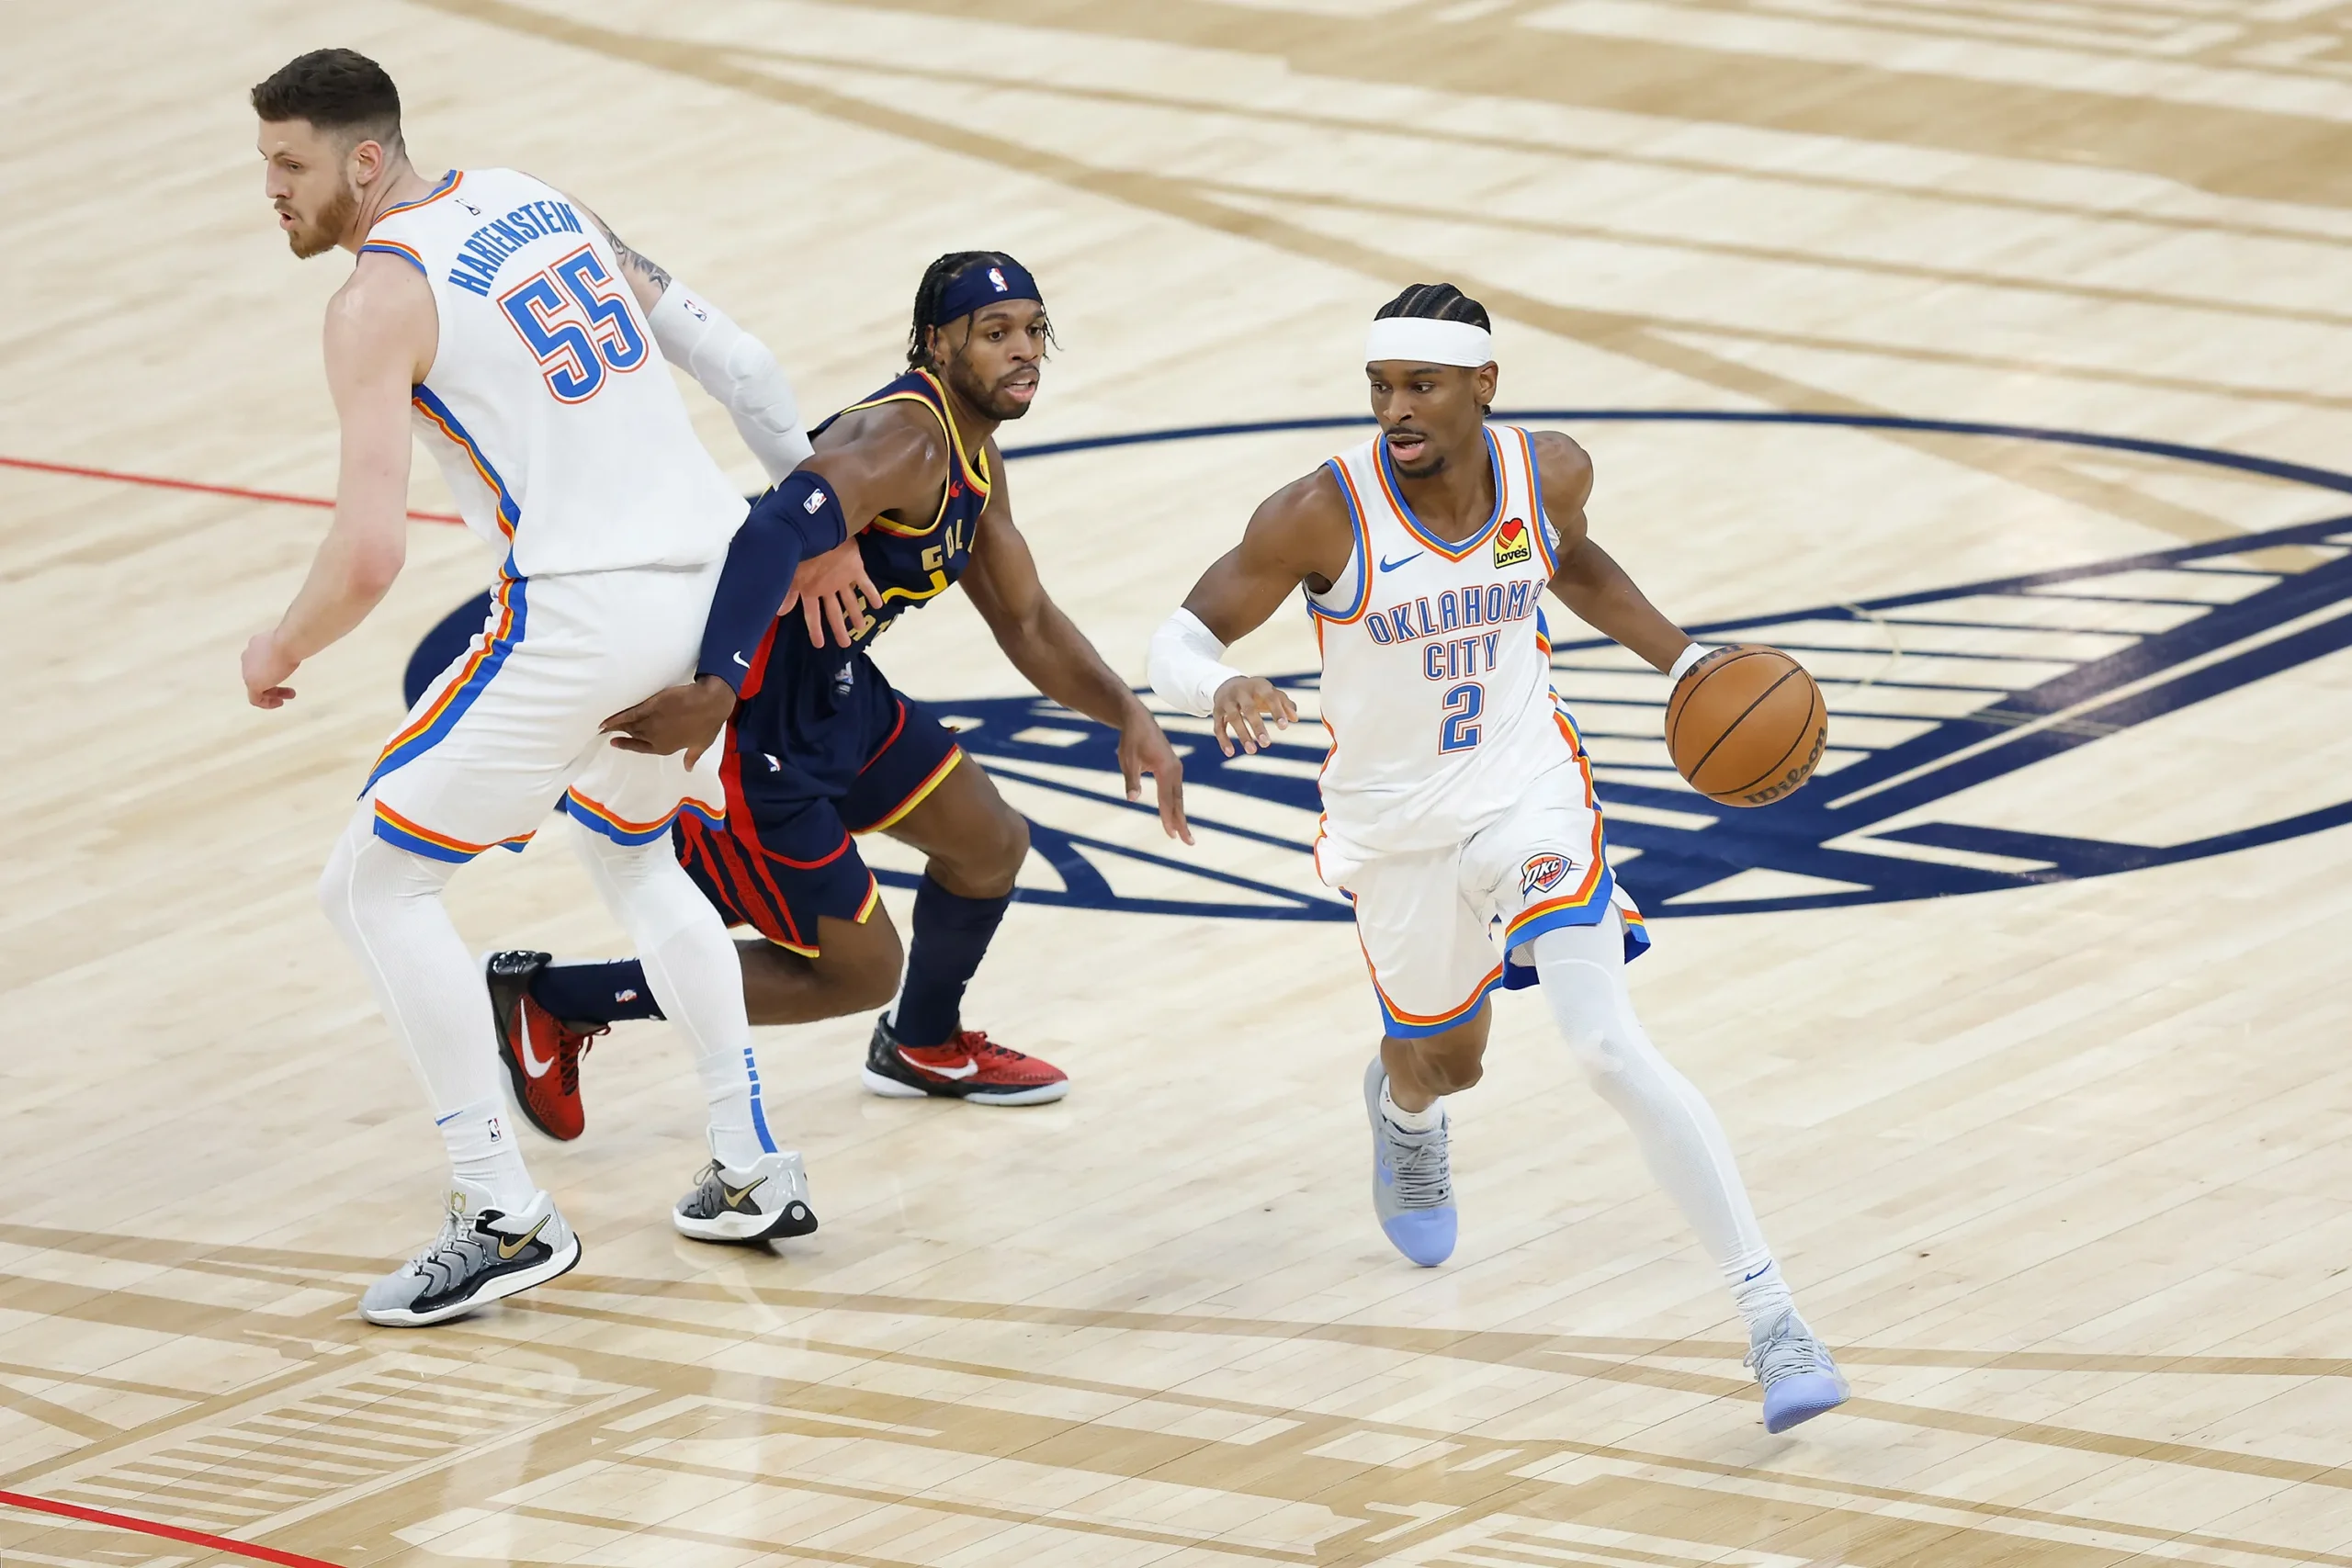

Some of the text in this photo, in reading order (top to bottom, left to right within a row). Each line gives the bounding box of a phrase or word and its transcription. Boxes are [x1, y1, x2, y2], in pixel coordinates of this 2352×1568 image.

[447, 200, 583, 298] HARTENSTEIN
[496, 243, 650, 405] 55
[1364, 579, 1546, 645] OKLAHOMA
[1423, 629, 1501, 681] CITY
[1438, 681, 1486, 756] 2
[1743, 727, 1826, 804] Wilson
[1522, 859, 1561, 895] OKC
